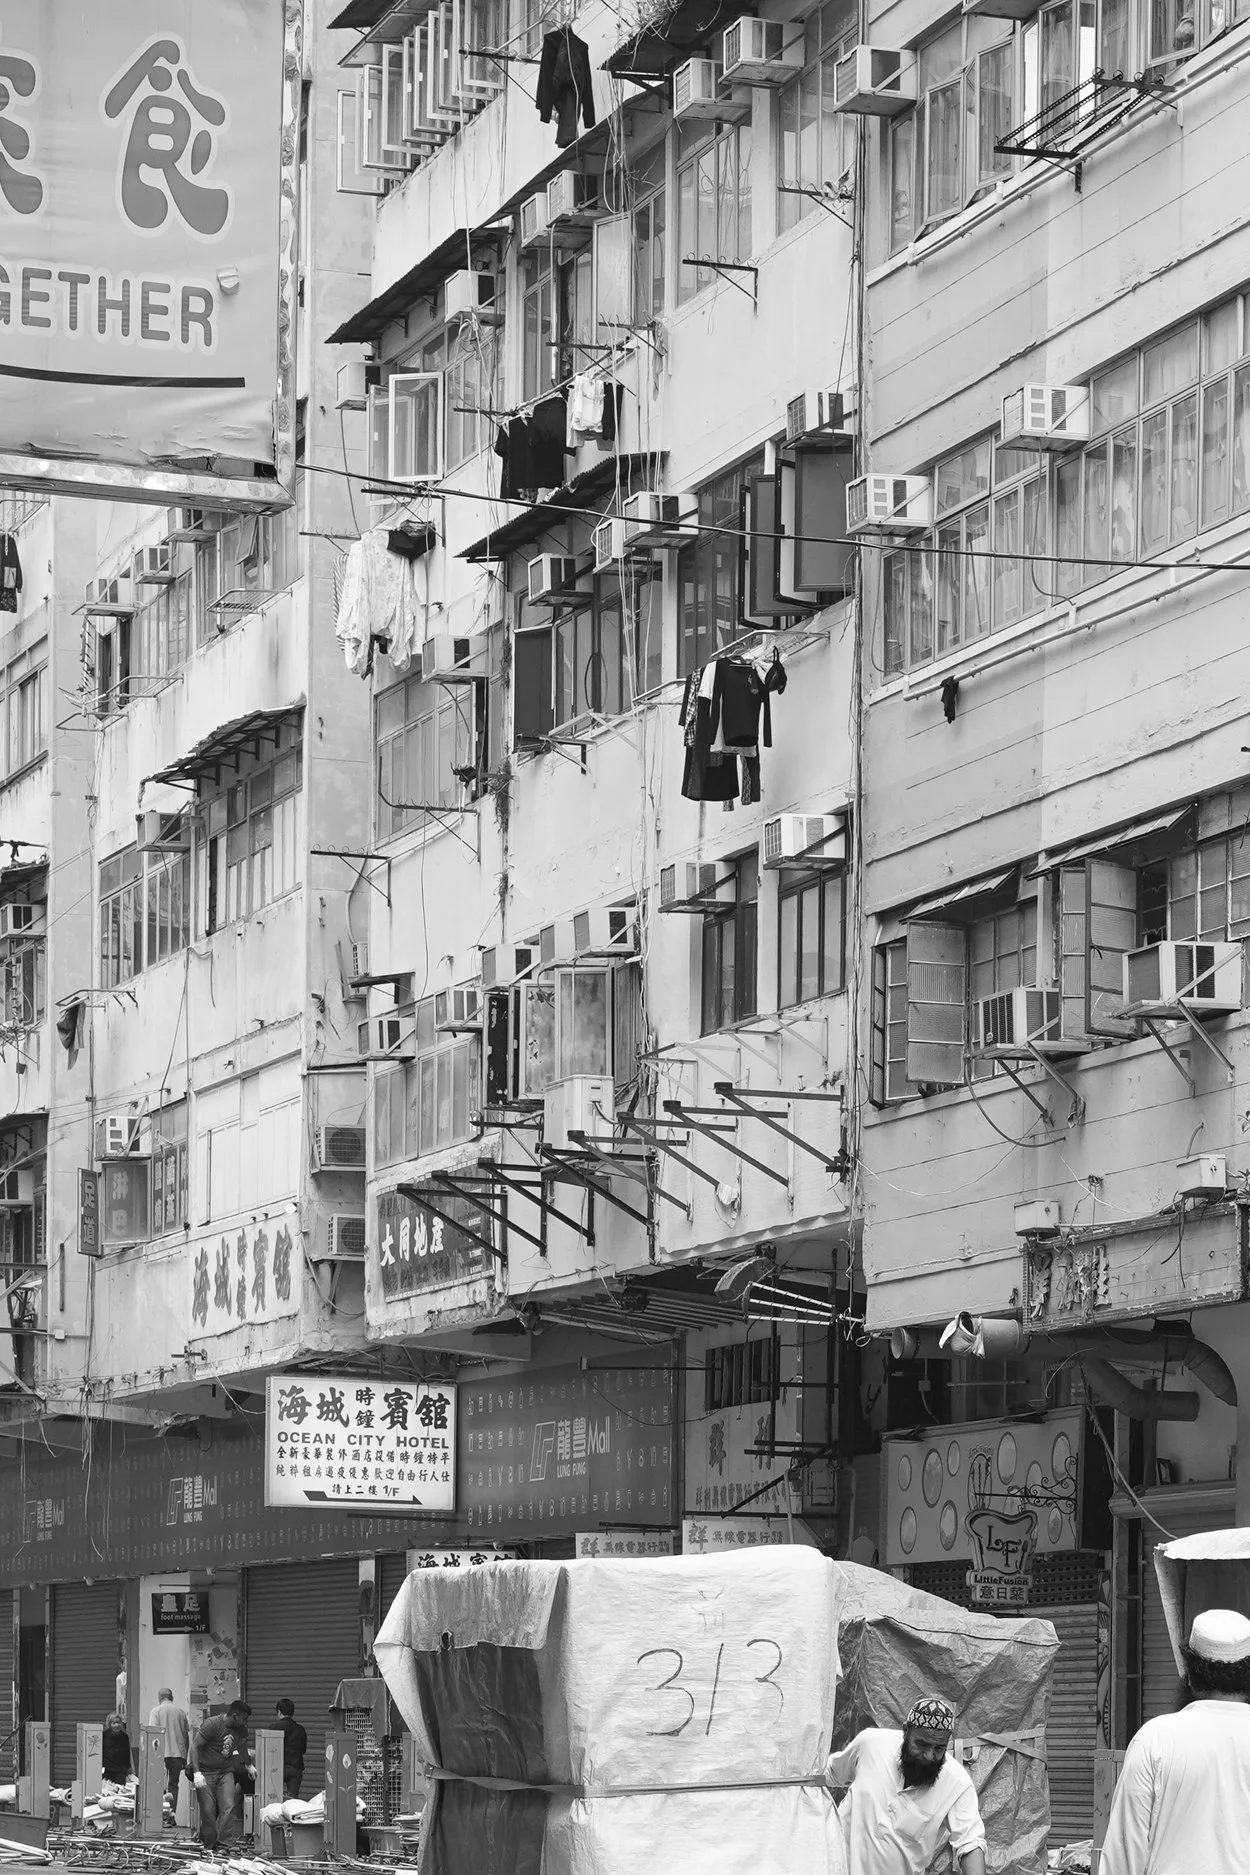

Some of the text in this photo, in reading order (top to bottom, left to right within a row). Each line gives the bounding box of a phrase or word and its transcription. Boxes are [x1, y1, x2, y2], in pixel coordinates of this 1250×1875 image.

[277, 1431, 450, 1449] OCEAN CITY HOTEL
[557, 1415, 610, 1460] 龍豐 Mall
[557, 1462, 586, 1478] LUNG FUNG
[203, 1475, 218, 1506] Mall
[332, 1484, 400, 1497] 請上二樓 1/F
[160, 1613, 174, 1621] foot
[637, 1638, 784, 1737] 313
